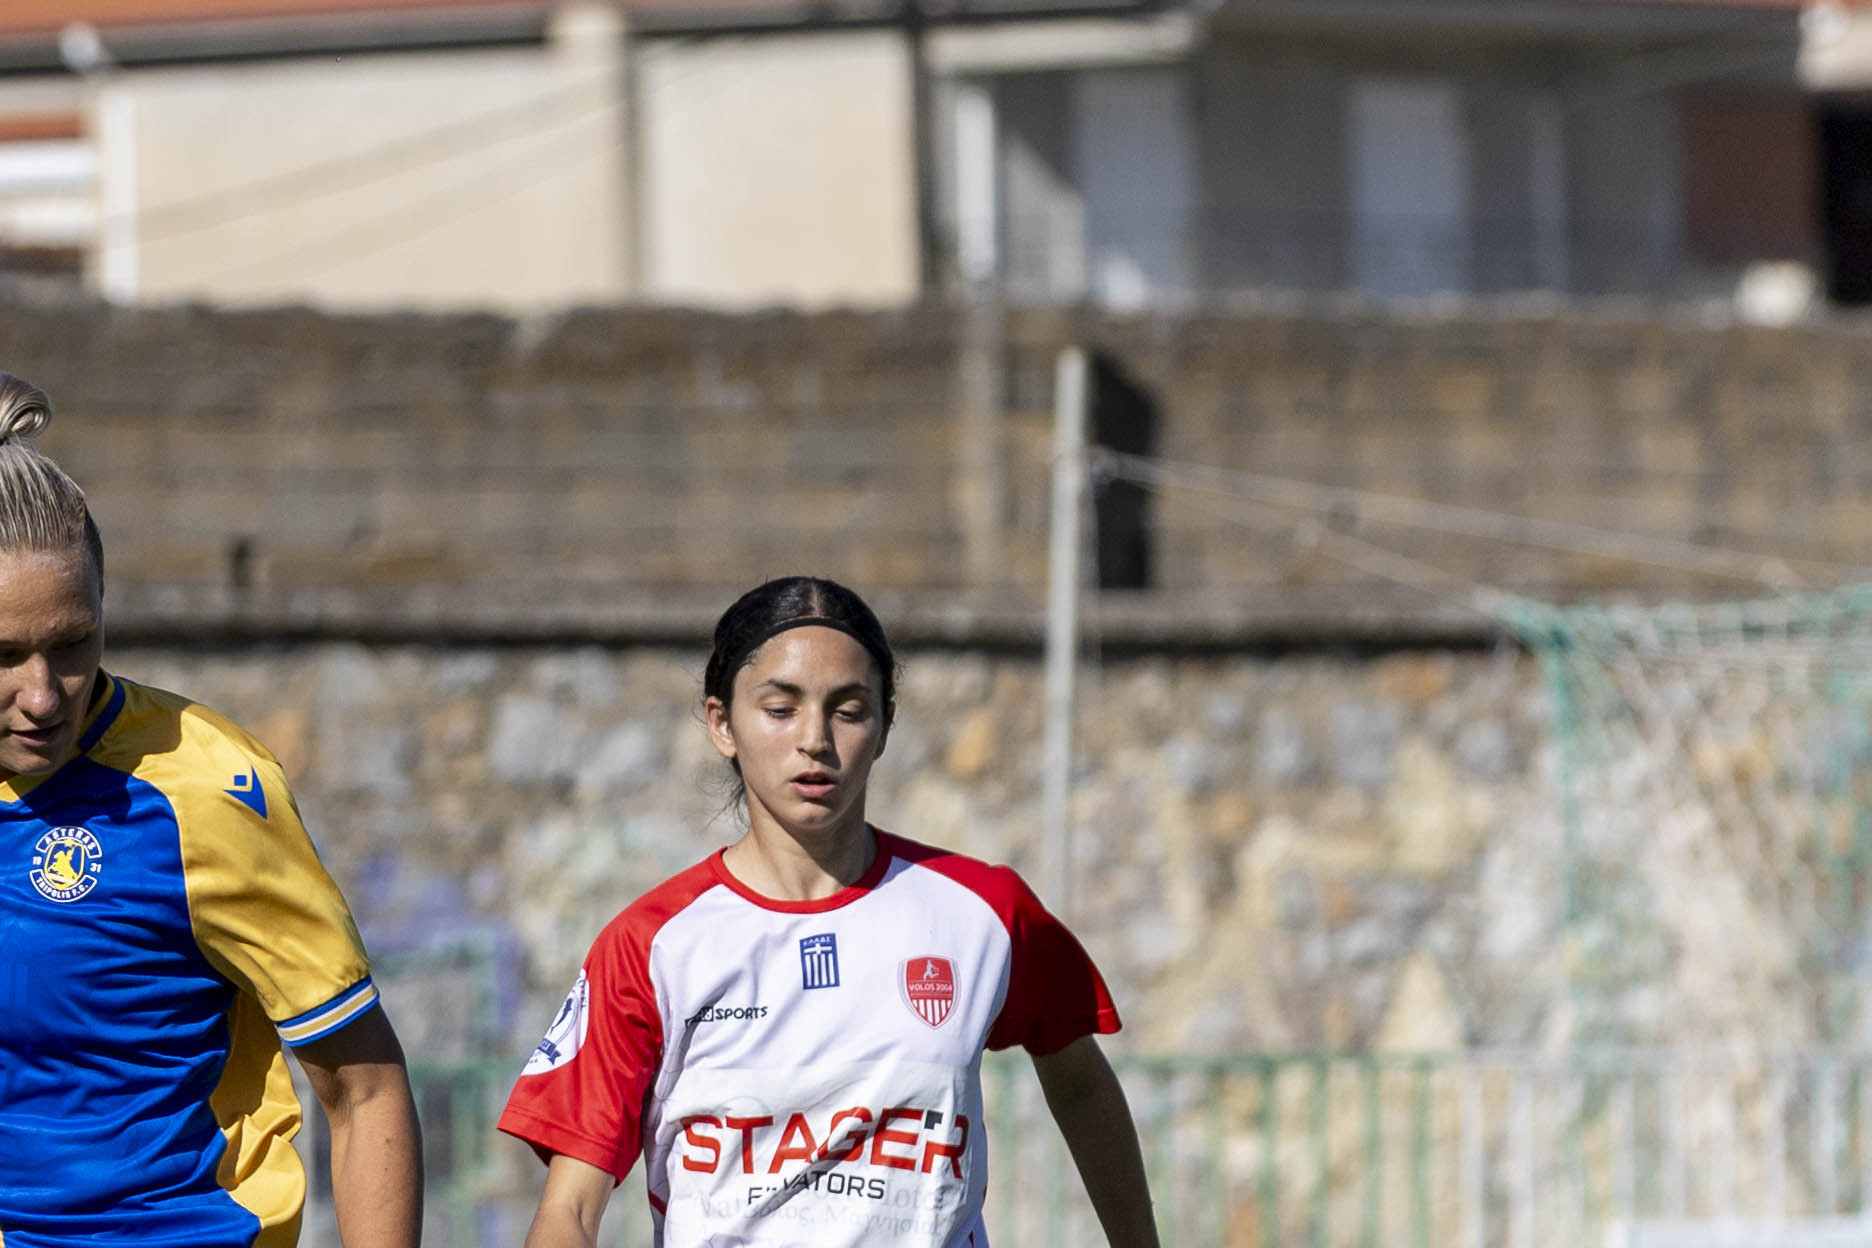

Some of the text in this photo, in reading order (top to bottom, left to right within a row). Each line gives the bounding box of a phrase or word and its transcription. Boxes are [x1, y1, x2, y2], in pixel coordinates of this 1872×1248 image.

[44, 828, 98, 851] ASTERAS
[35, 876, 72, 899] TRIPOLIS
[909, 983, 936, 992] VOLOS
[715, 1006, 768, 1020] SPORTS
[679, 1106, 969, 1180] STAGER
